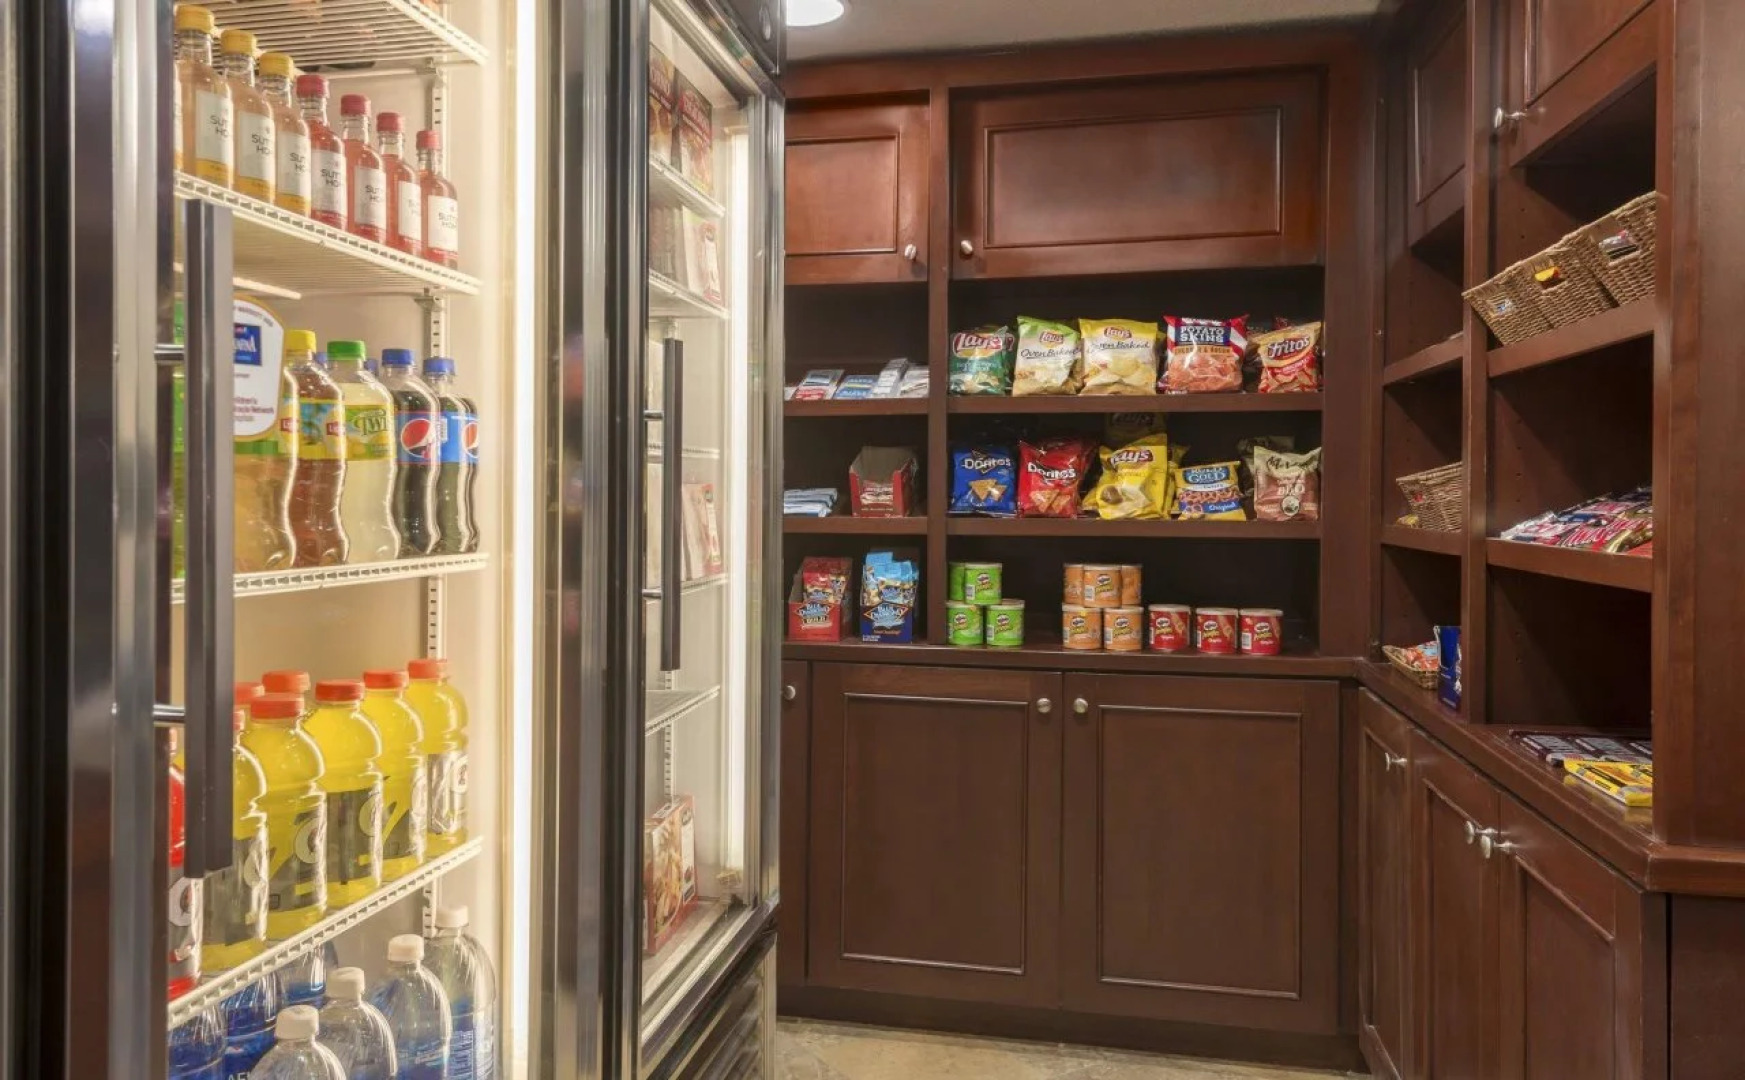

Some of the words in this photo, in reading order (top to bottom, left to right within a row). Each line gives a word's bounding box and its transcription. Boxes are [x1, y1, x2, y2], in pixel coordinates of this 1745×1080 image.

[1180, 326, 1225, 335] POTATO
[1180, 333, 1224, 343] SKINS
[1020, 348, 1046, 359] Oven
[963, 457, 1011, 470] Doritos
[1027, 461, 1077, 479] Doritos
[1188, 471, 1226, 484] GOLD
